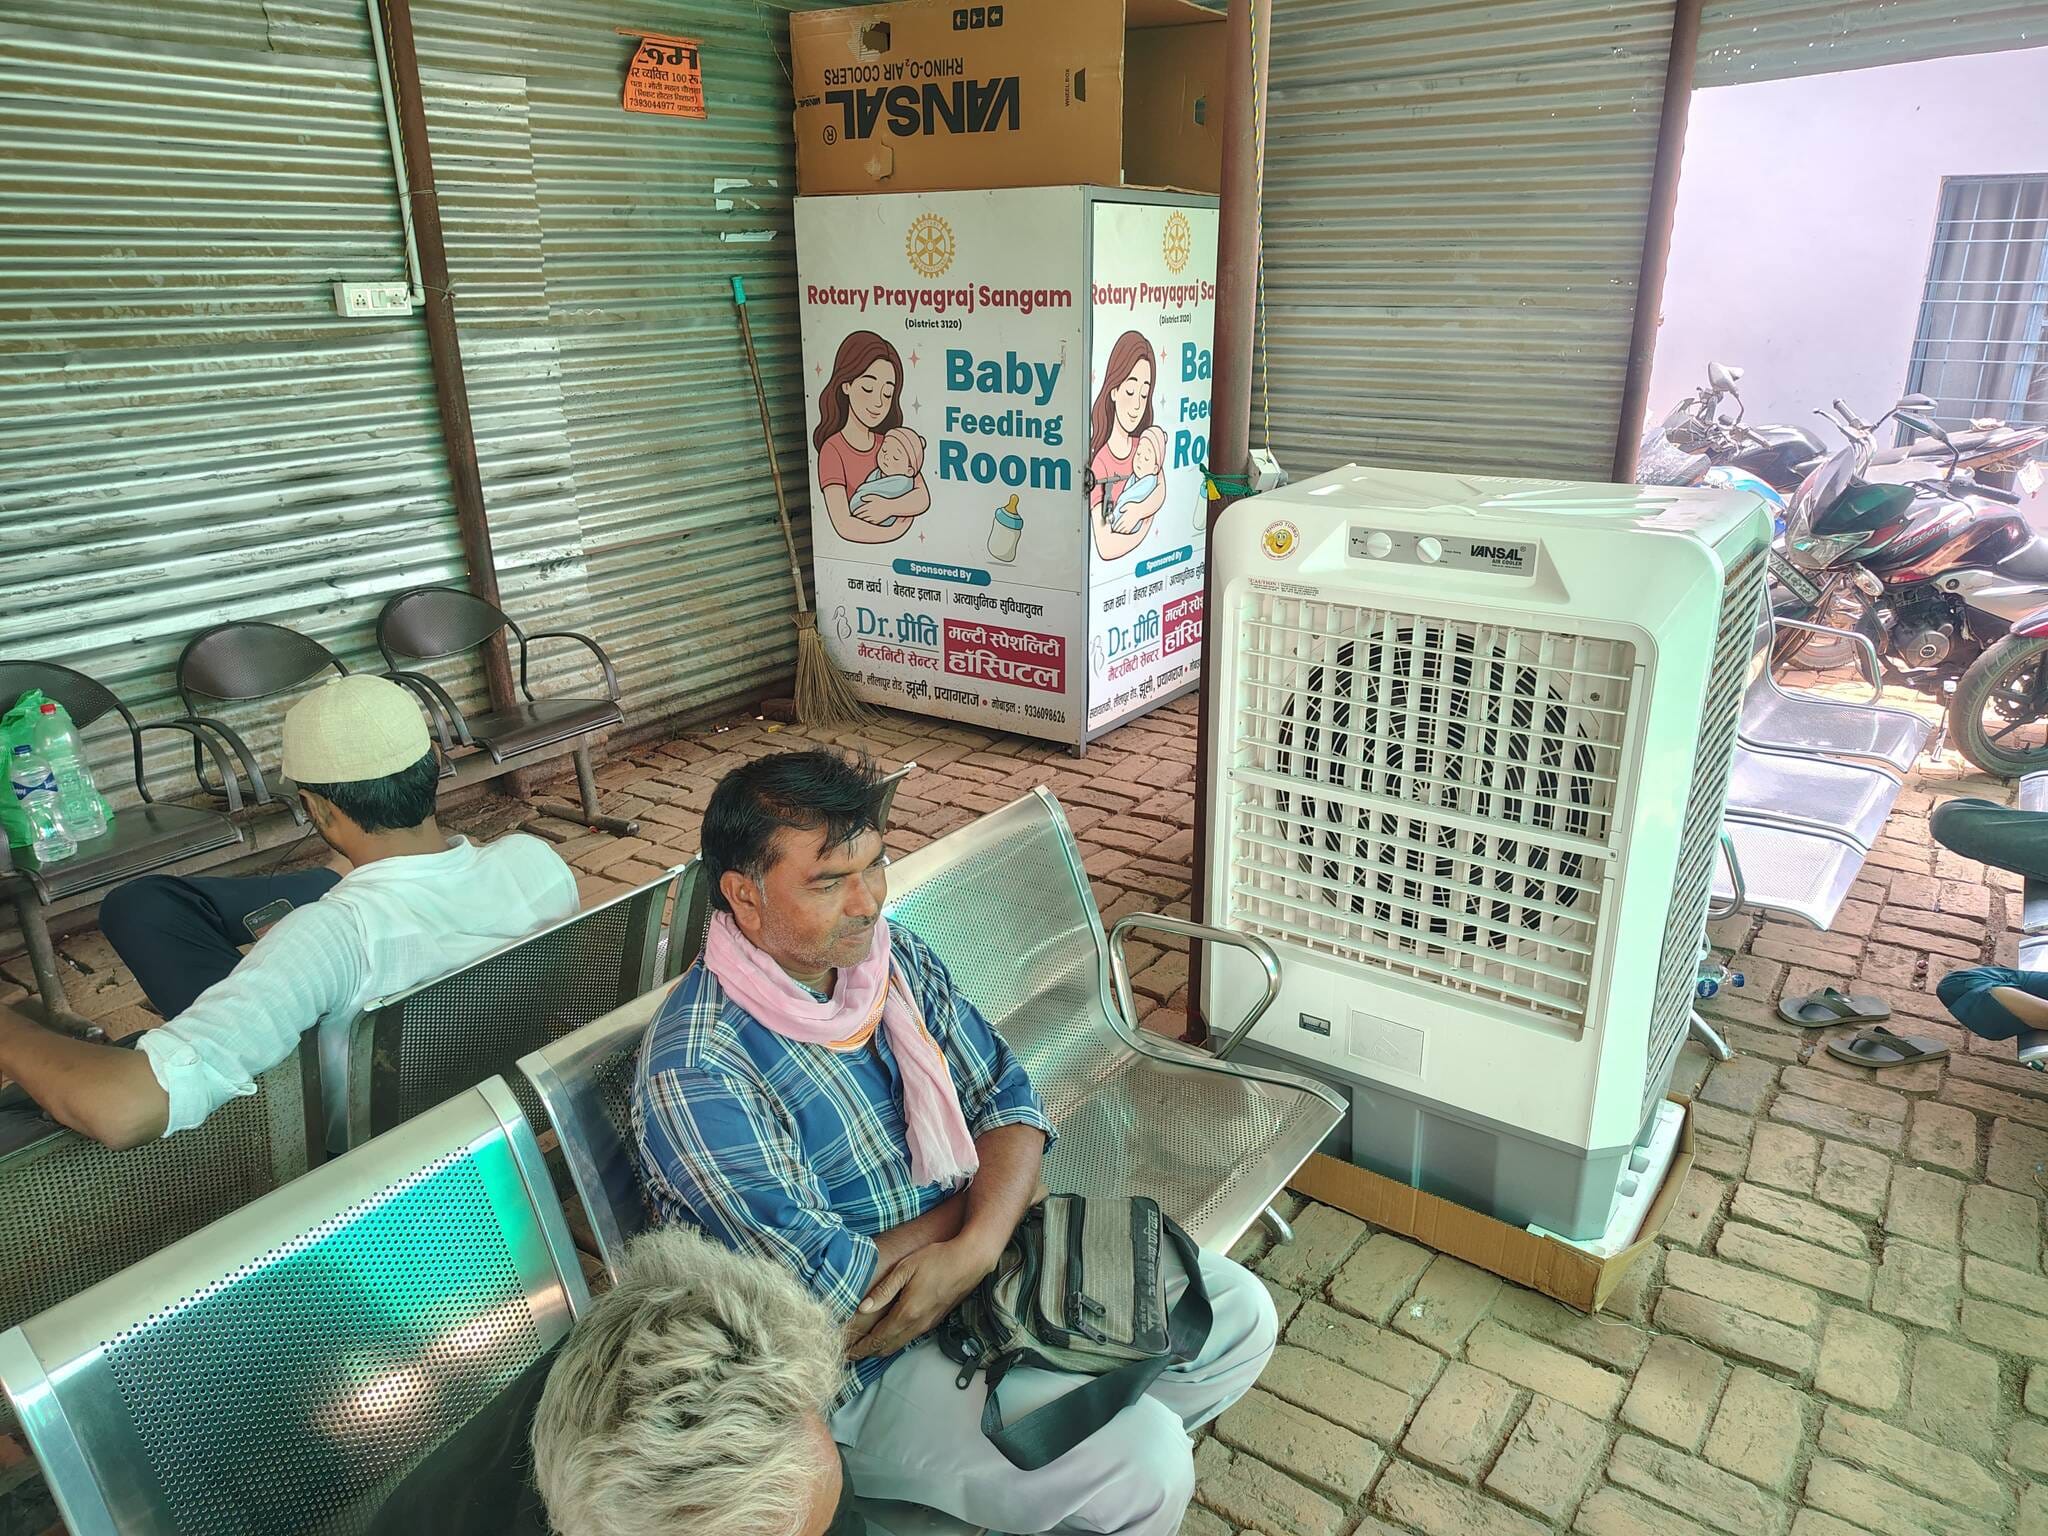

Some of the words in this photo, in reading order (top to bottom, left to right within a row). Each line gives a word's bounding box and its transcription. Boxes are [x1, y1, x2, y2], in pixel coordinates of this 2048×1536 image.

[672, 73, 687, 83] 100
[824, 65, 881, 86] COOLERS
[883, 62, 904, 82] AIR
[825, 77, 1020, 140] VANSAL
[808, 284, 870, 312] Rotary
[873, 282, 975, 314] Prayagraj
[979, 284, 1072, 315] Sangam
[1140, 279, 1199, 310] Prayagraj
[905, 318, 939, 330] (District
[940, 319, 963, 331] 3120)
[1159, 314, 1179, 326] (District
[946, 349, 1062, 406] Baby
[946, 406, 1064, 446] Feeding
[939, 439, 1072, 492] Room
[1470, 544, 1523, 561] VANSAL
[848, 577, 864, 591] कम
[866, 577, 882, 594] खर्च
[910, 562, 959, 579] Sponsored
[959, 570, 972, 583] By
[893, 580, 916, 599] बेहतर
[917, 588, 941, 603] इलाज
[1103, 597, 1115, 613] कम
[1133, 584, 1148, 602] बेहतर
[1148, 580, 1164, 598] इलाज
[953, 592, 998, 610] अत्याधुनिक
[999, 597, 1043, 620] सुविधायुक्त
[1165, 601, 1188, 623] मल्टी
[856, 606, 893, 640] Dr.
[896, 611, 939, 648] प्रीति
[948, 623, 988, 650] मल्टी
[989, 628, 1060, 658] स्पेशलिटी
[1108, 625, 1131, 658] Dr.
[1132, 608, 1160, 649] प्रीति
[858, 643, 905, 665] मैटरनिटी
[907, 651, 939, 671] सेन्टर
[948, 648, 1060, 689] हॉस्पिटल
[1107, 656, 1139, 682] मैटरनिटी
[1140, 648, 1160, 668] सेन्टर
[1156, 664, 1184, 689] प्रयागराज
[933, 685, 980, 708] प्रयागराज
[1024, 704, 1066, 724] 9336098626
